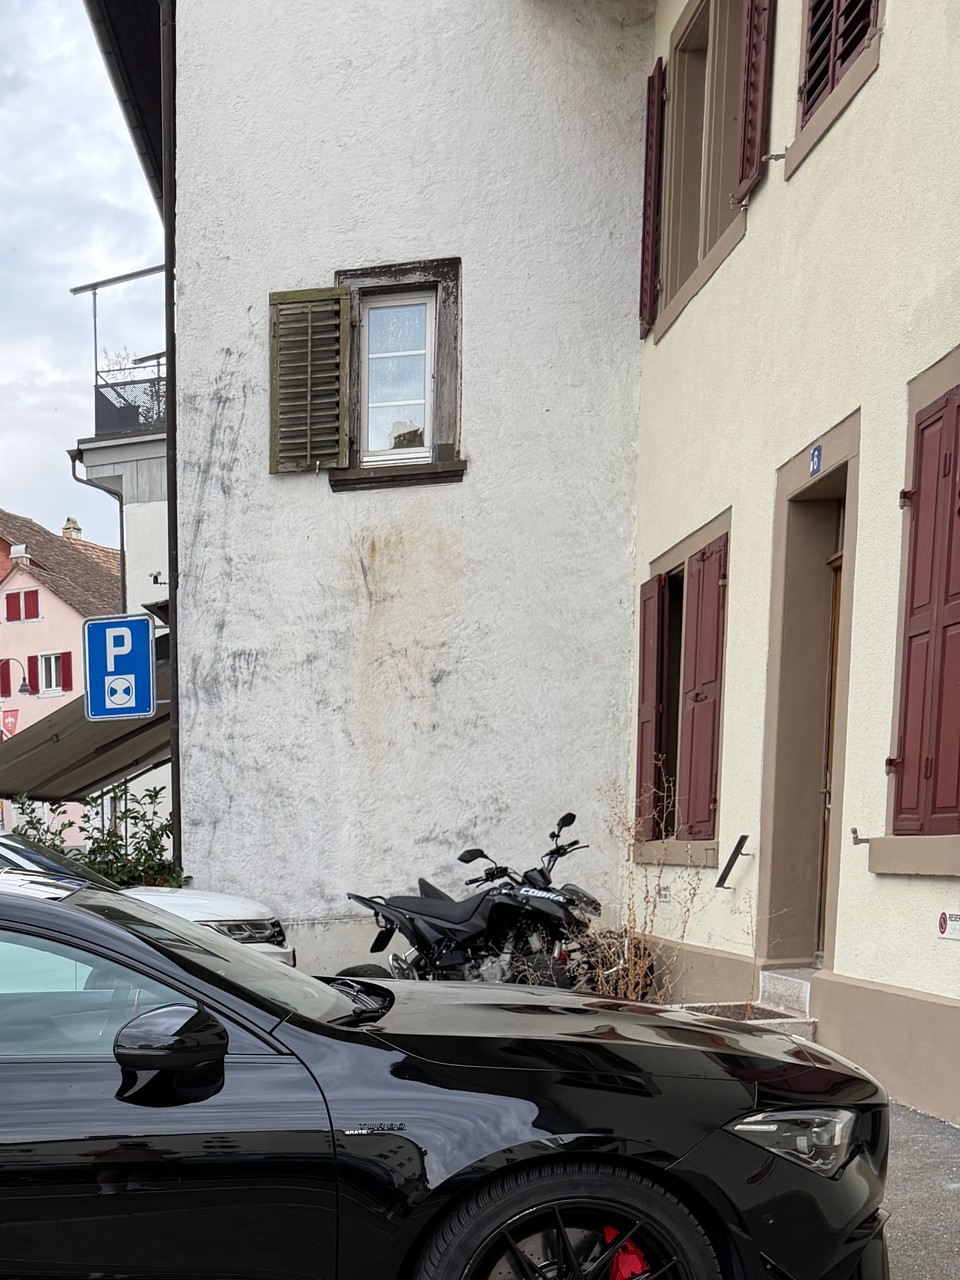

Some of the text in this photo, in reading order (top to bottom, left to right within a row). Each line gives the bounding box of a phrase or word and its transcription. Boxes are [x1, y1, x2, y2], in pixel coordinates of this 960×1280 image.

[105, 627, 132, 672] P
[519, 887, 566, 903] COBRA
[358, 1123, 406, 1131] TURBO
